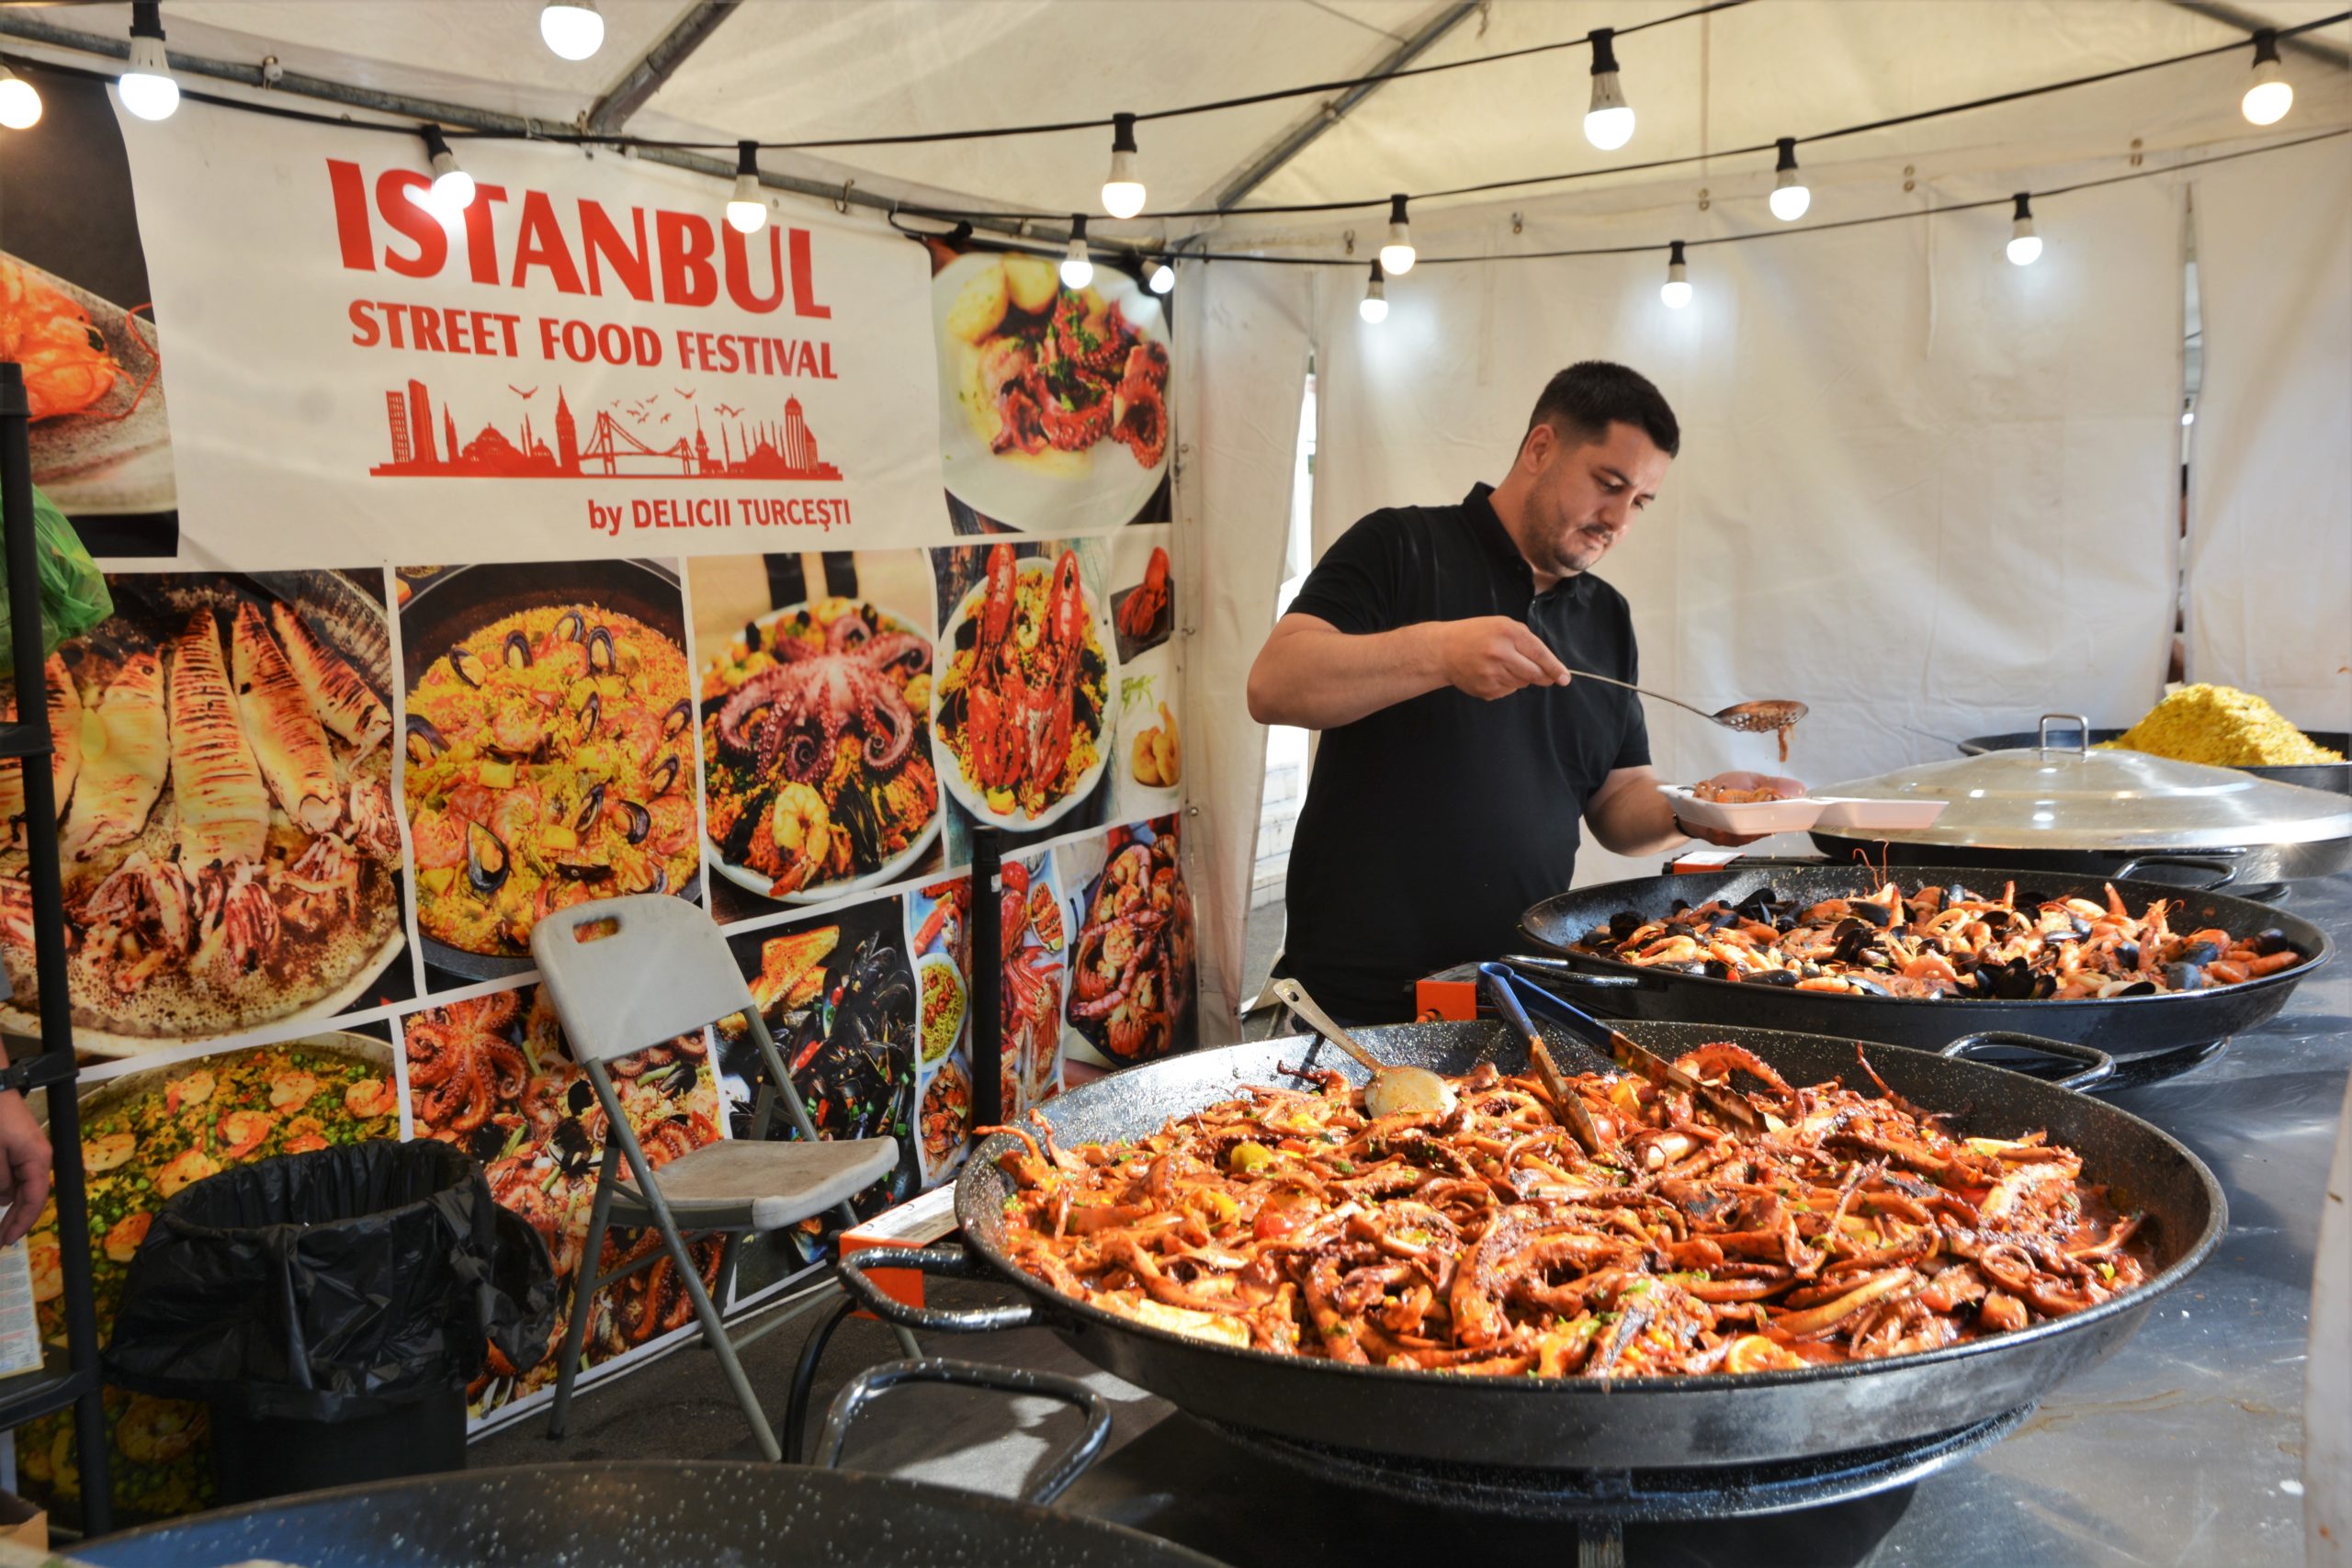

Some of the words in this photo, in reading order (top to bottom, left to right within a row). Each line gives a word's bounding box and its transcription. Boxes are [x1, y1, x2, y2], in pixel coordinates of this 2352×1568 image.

[325, 157, 831, 320] ISTANBUL
[348, 299, 521, 358] STREET
[538, 316, 662, 367] FOOD
[676, 330, 839, 380] FESTIVAL
[587, 499, 624, 537] by
[631, 499, 732, 530] DELICII
